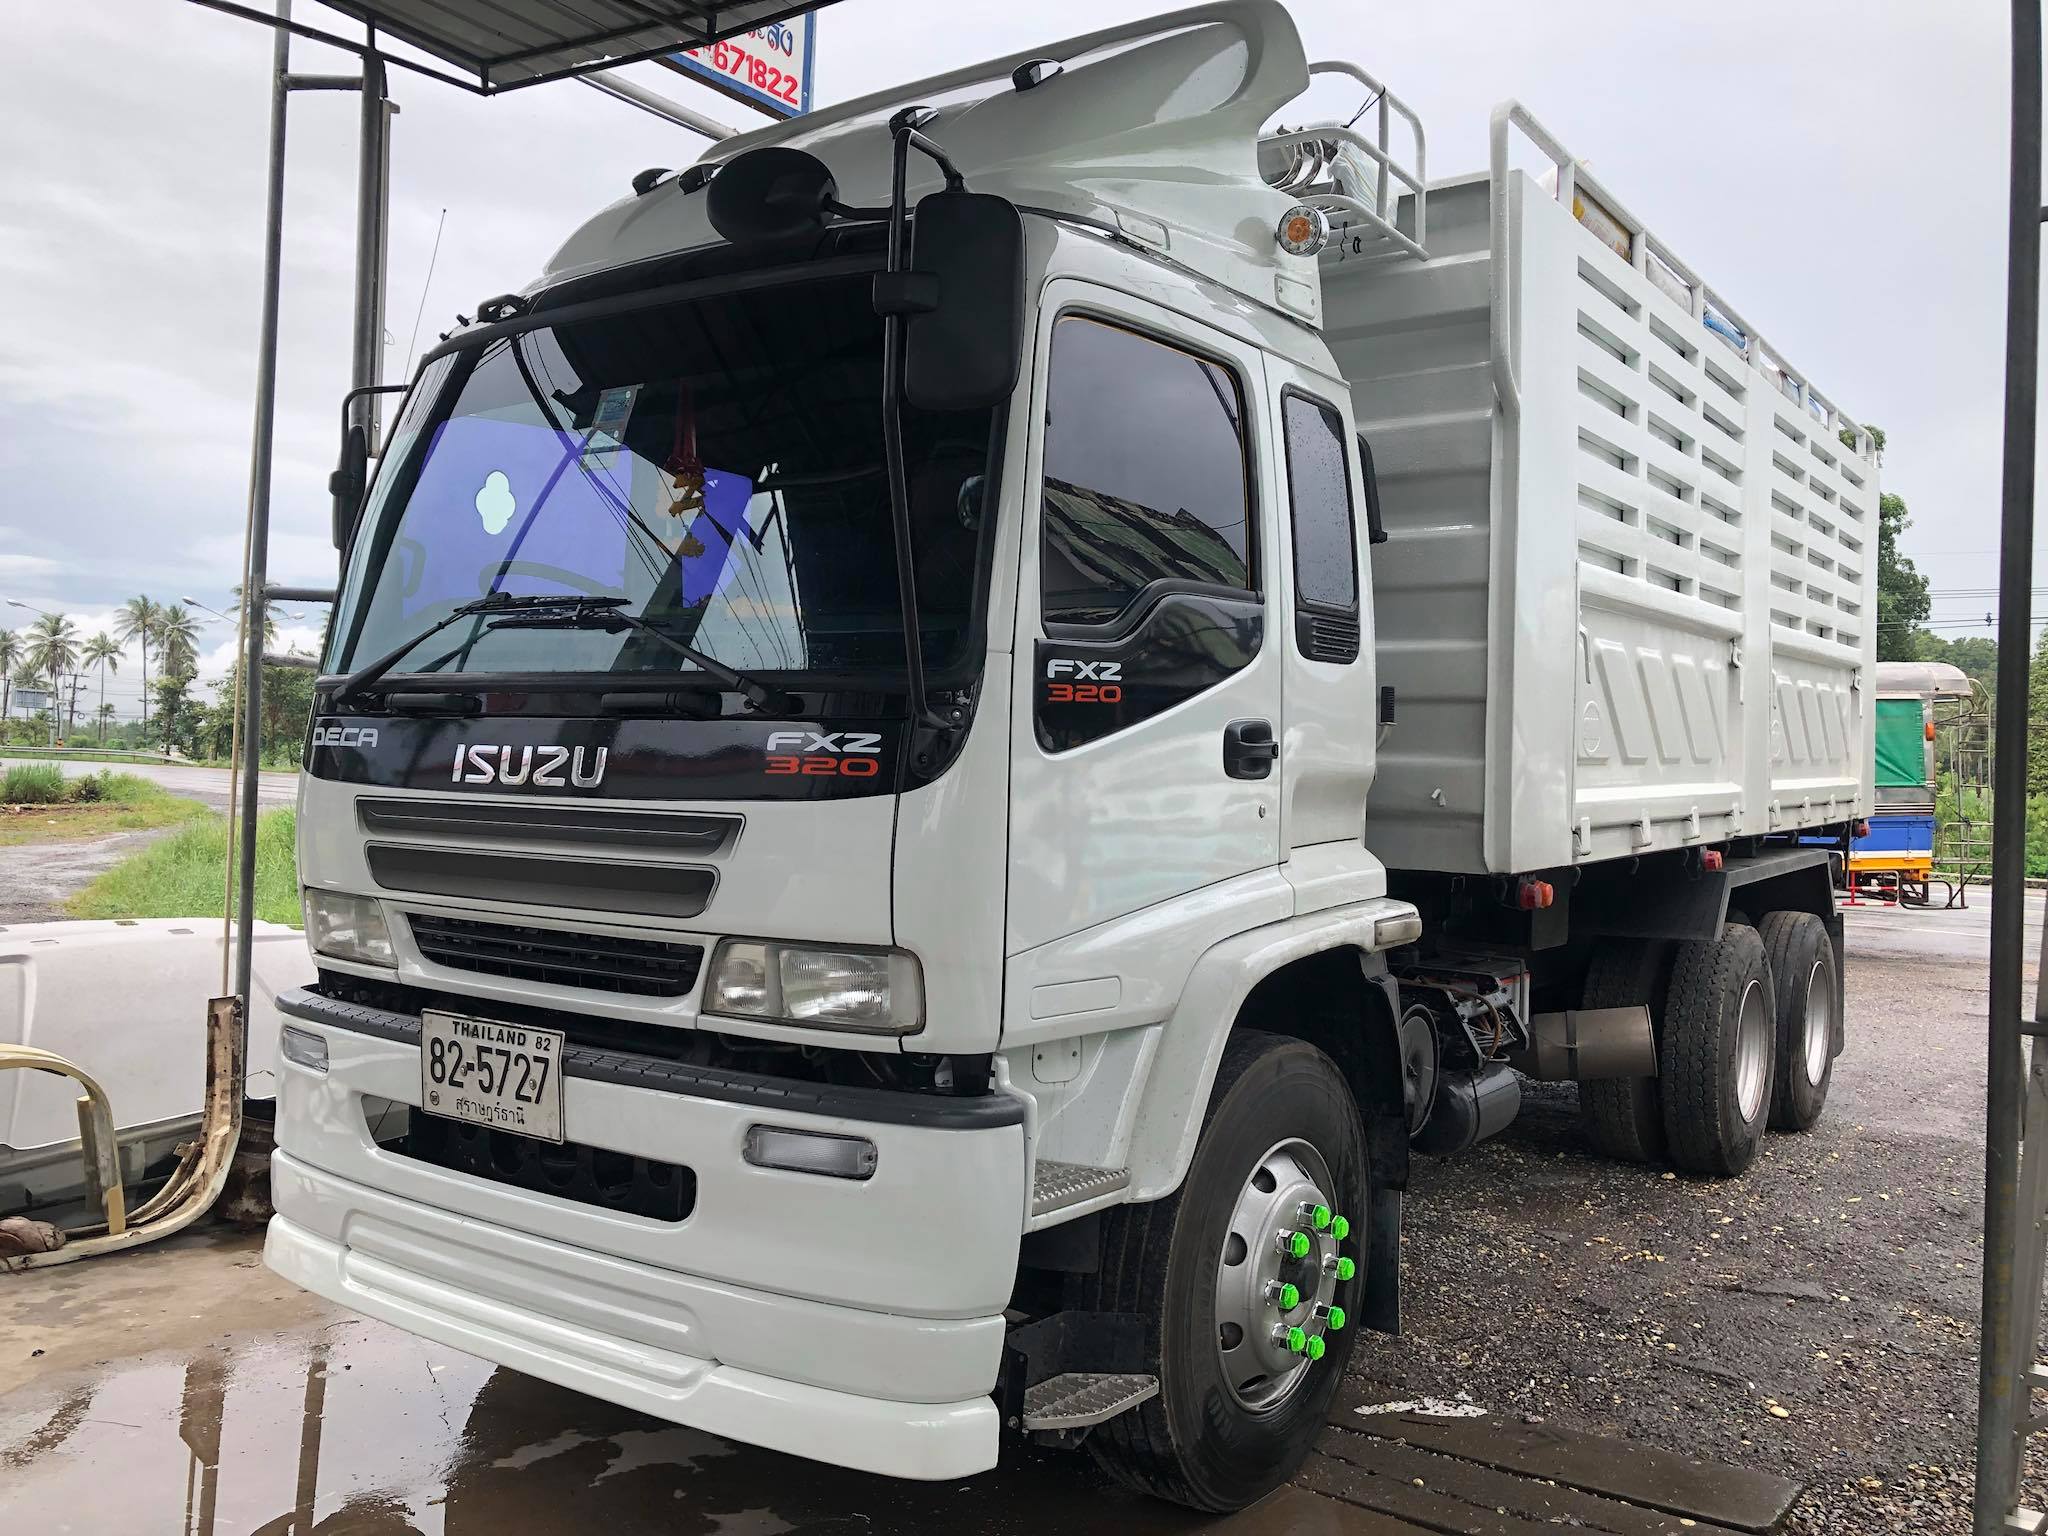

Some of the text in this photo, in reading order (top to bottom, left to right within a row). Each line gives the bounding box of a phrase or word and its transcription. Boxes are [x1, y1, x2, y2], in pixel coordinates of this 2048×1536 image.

[1047, 659, 1122, 681] FXZ
[1047, 683, 1122, 703] 320
[312, 727, 379, 748] DECA
[766, 731, 882, 753] FXZ
[452, 743, 609, 788] ISUZU
[764, 756, 879, 776] 320
[452, 1020, 551, 1051] THAILAND 82
[430, 1037, 550, 1105] 82-5727
